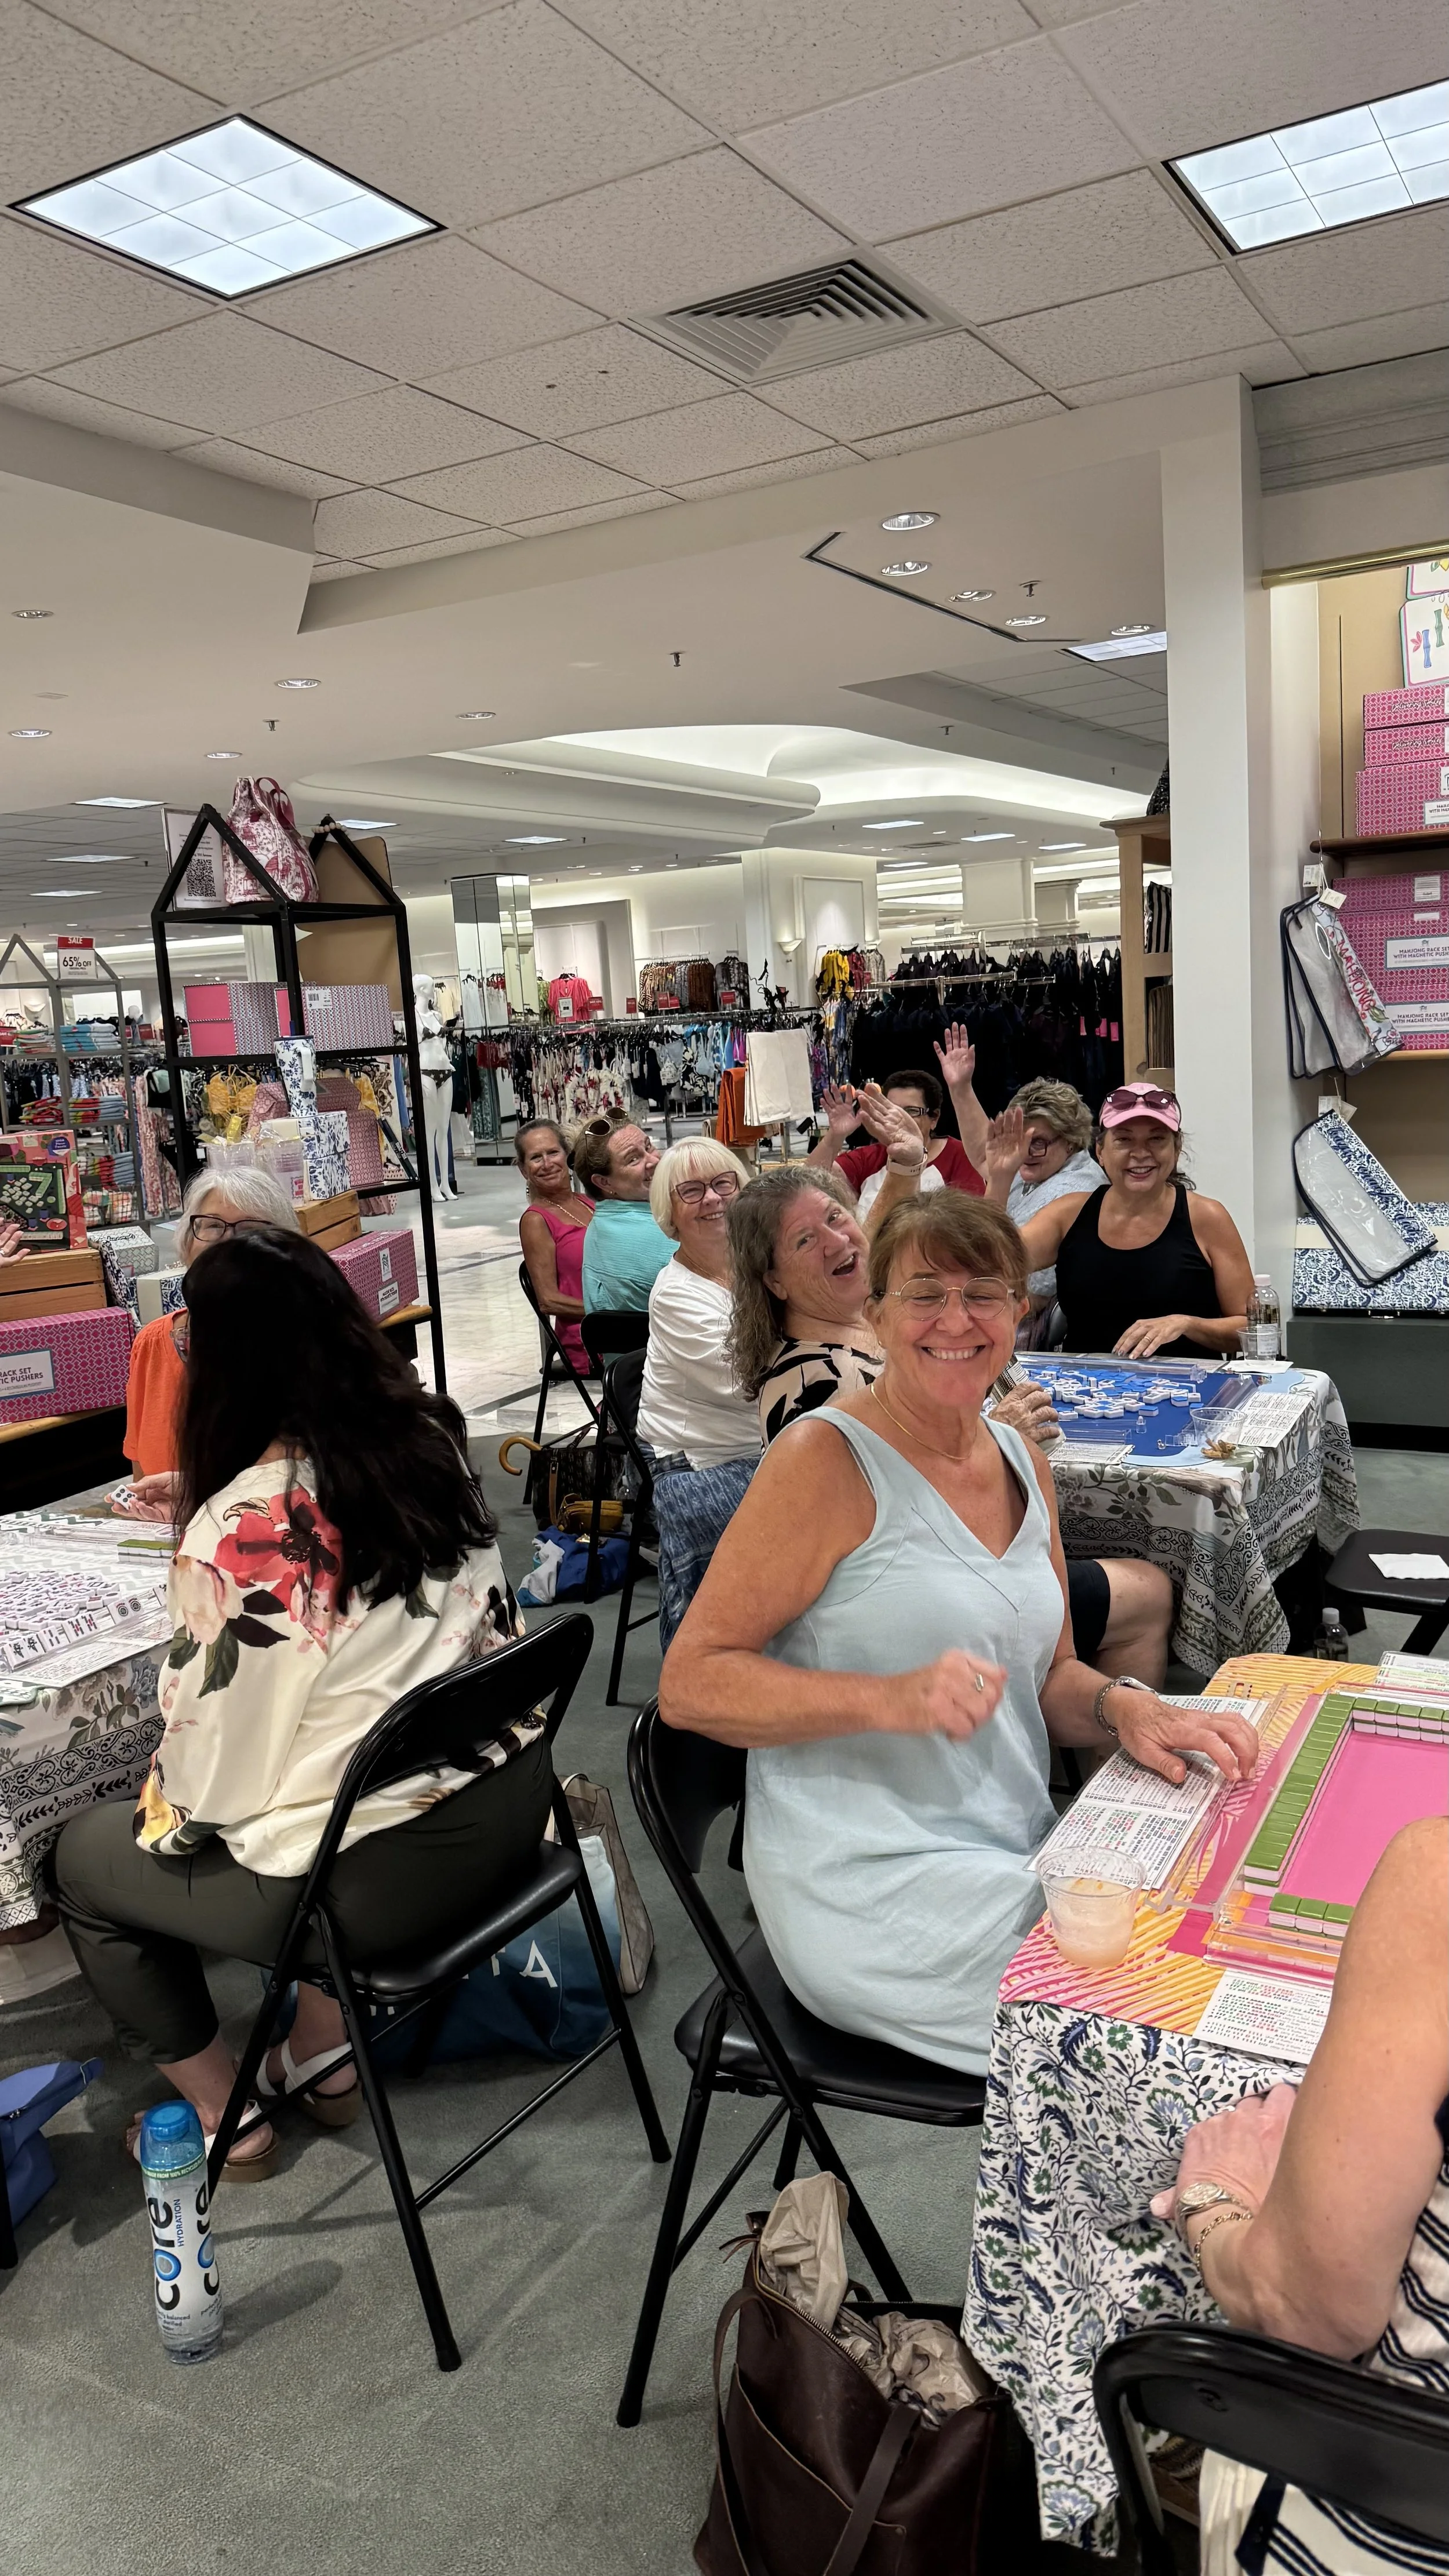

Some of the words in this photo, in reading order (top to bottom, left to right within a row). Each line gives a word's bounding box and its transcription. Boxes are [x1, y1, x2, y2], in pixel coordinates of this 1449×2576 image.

[63, 956, 82, 967] 65%
[19, 1367, 31, 1375] SET
[10, 1372, 43, 1383] PUSHERS
[173, 2198, 184, 2247] HYDRATION
[147, 2197, 182, 2311] core
